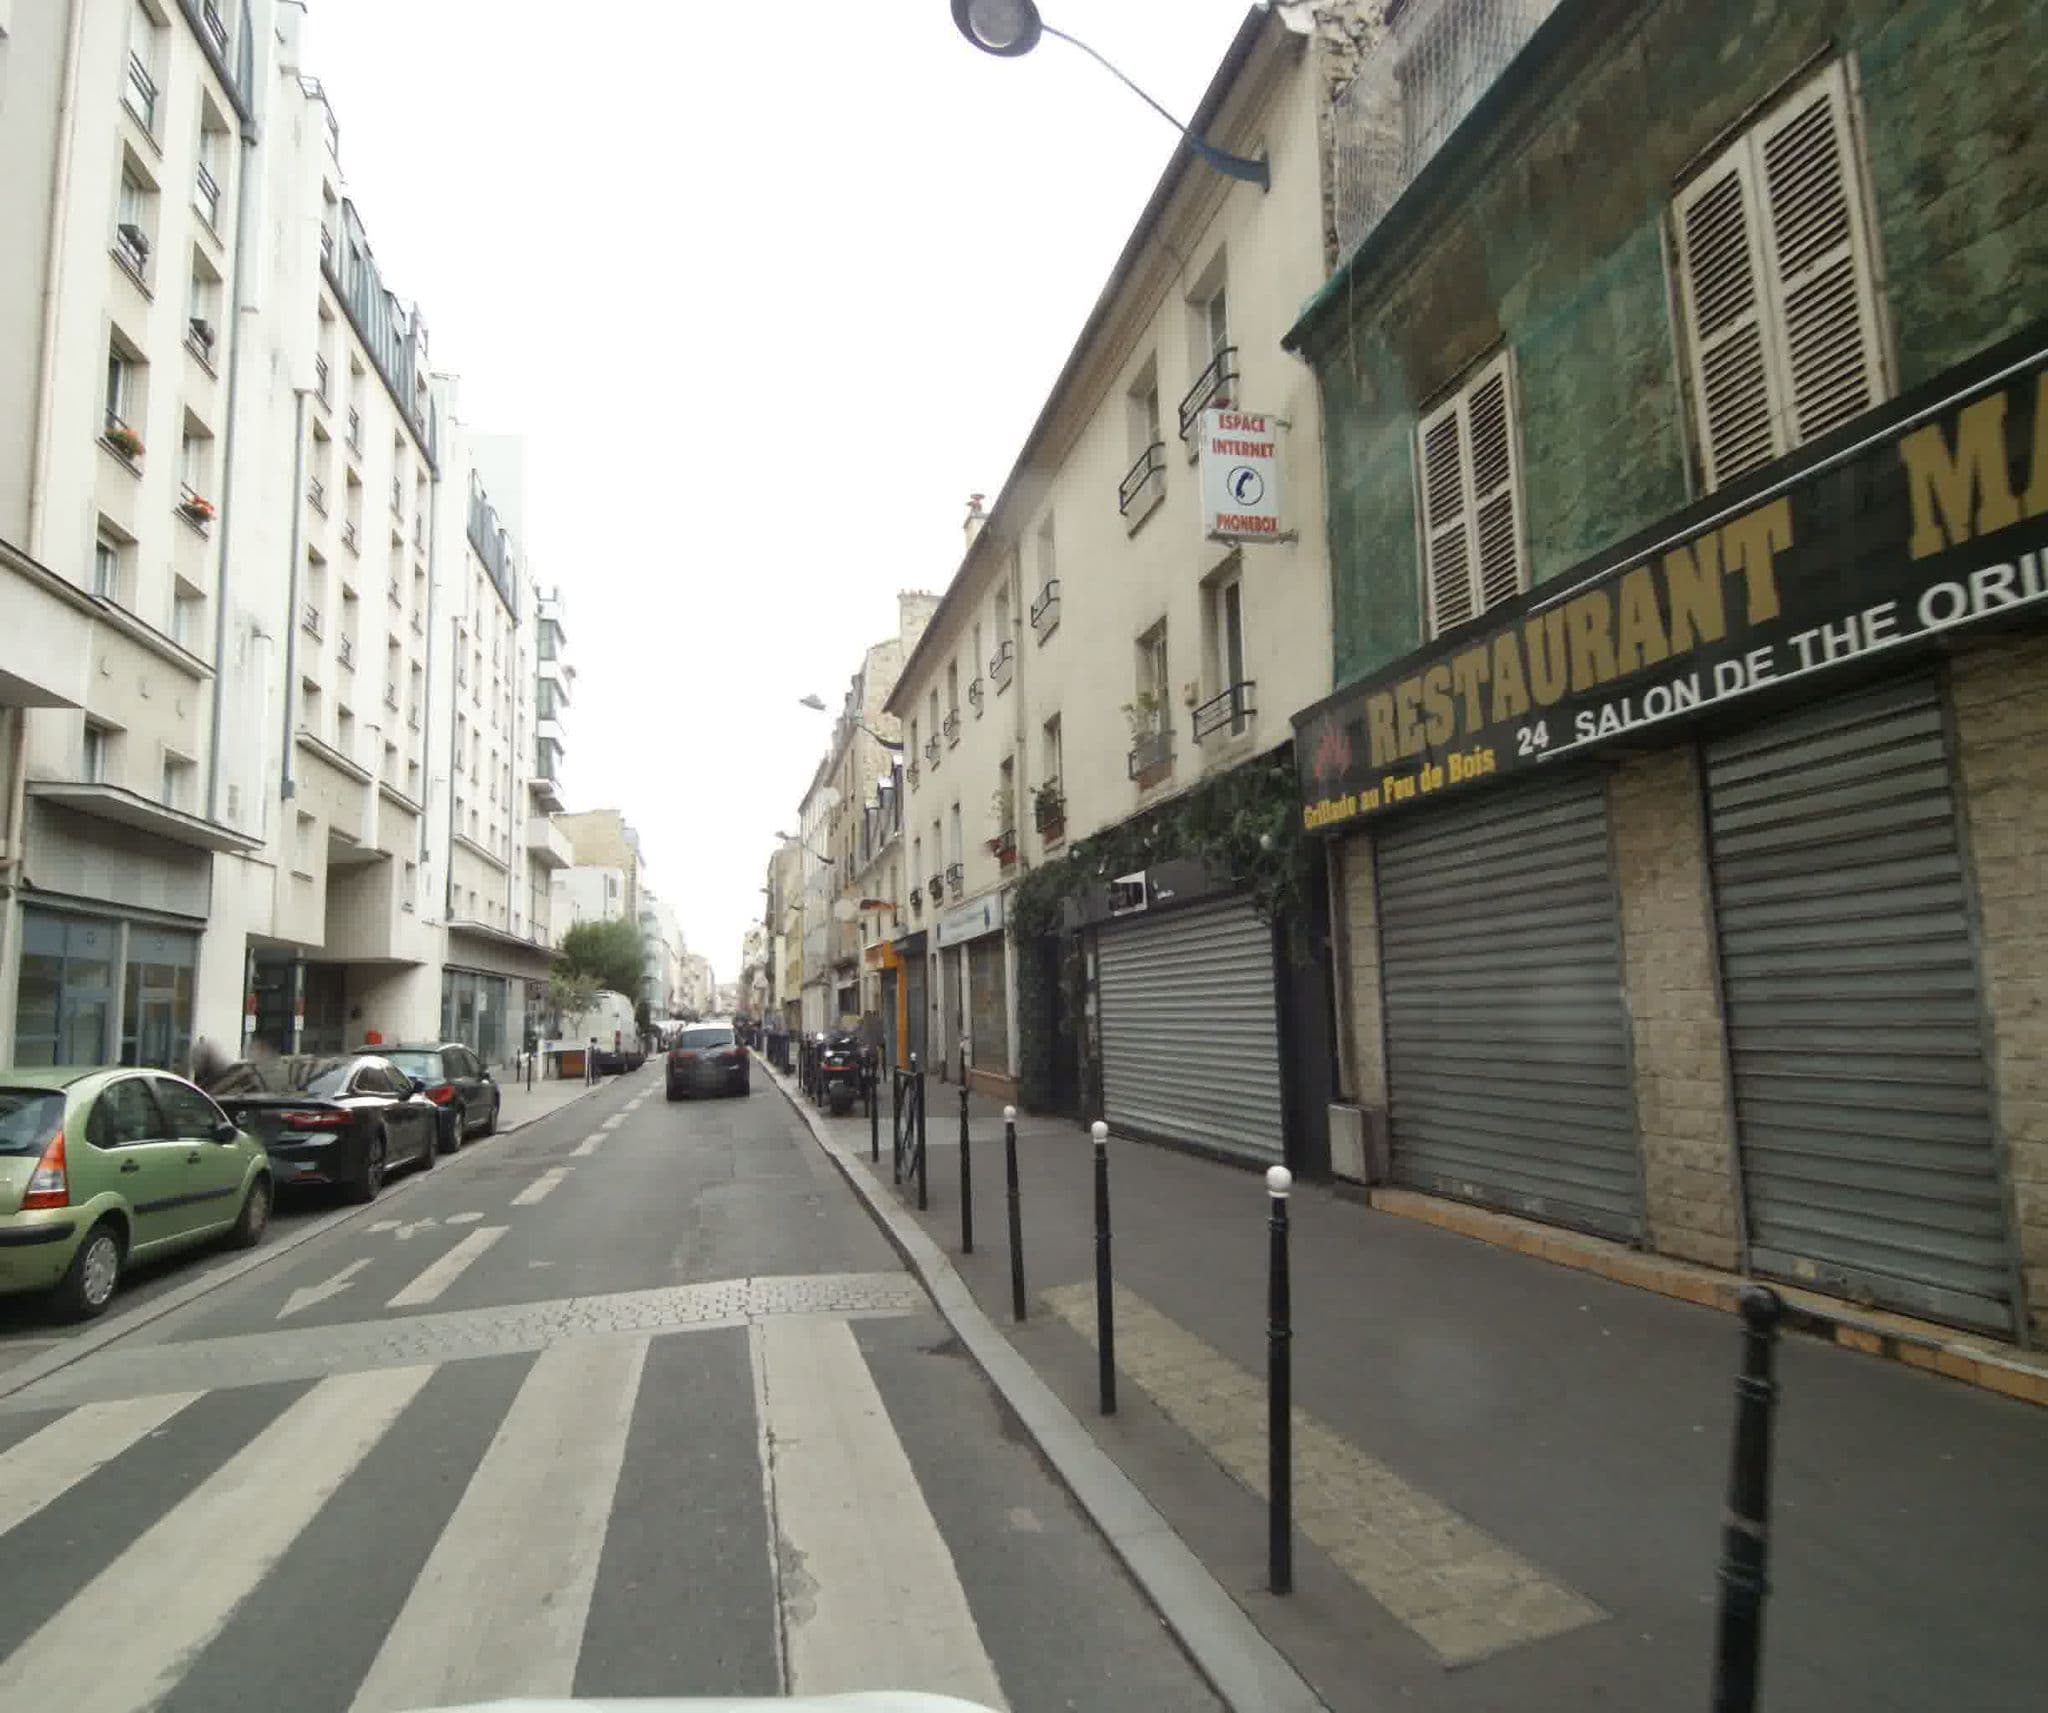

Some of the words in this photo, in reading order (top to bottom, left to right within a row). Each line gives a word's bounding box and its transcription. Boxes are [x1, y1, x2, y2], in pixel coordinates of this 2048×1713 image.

[1218, 414, 1265, 432] ESPACE
[1212, 438, 1274, 458] INTERNET
[1216, 513, 1277, 532] PHONEBOX
[1366, 496, 1793, 767] RESTAURANT
[1516, 720, 1549, 756] 24
[1575, 672, 1701, 742] SALON
[1714, 645, 1777, 698] DE
[1788, 601, 1898, 670] THE
[1917, 547, 2048, 628] ORI
[1361, 789, 1379, 811] au
[1382, 776, 1415, 803] Feu
[1420, 763, 1443, 791] de
[1448, 745, 1496, 783] Bois
